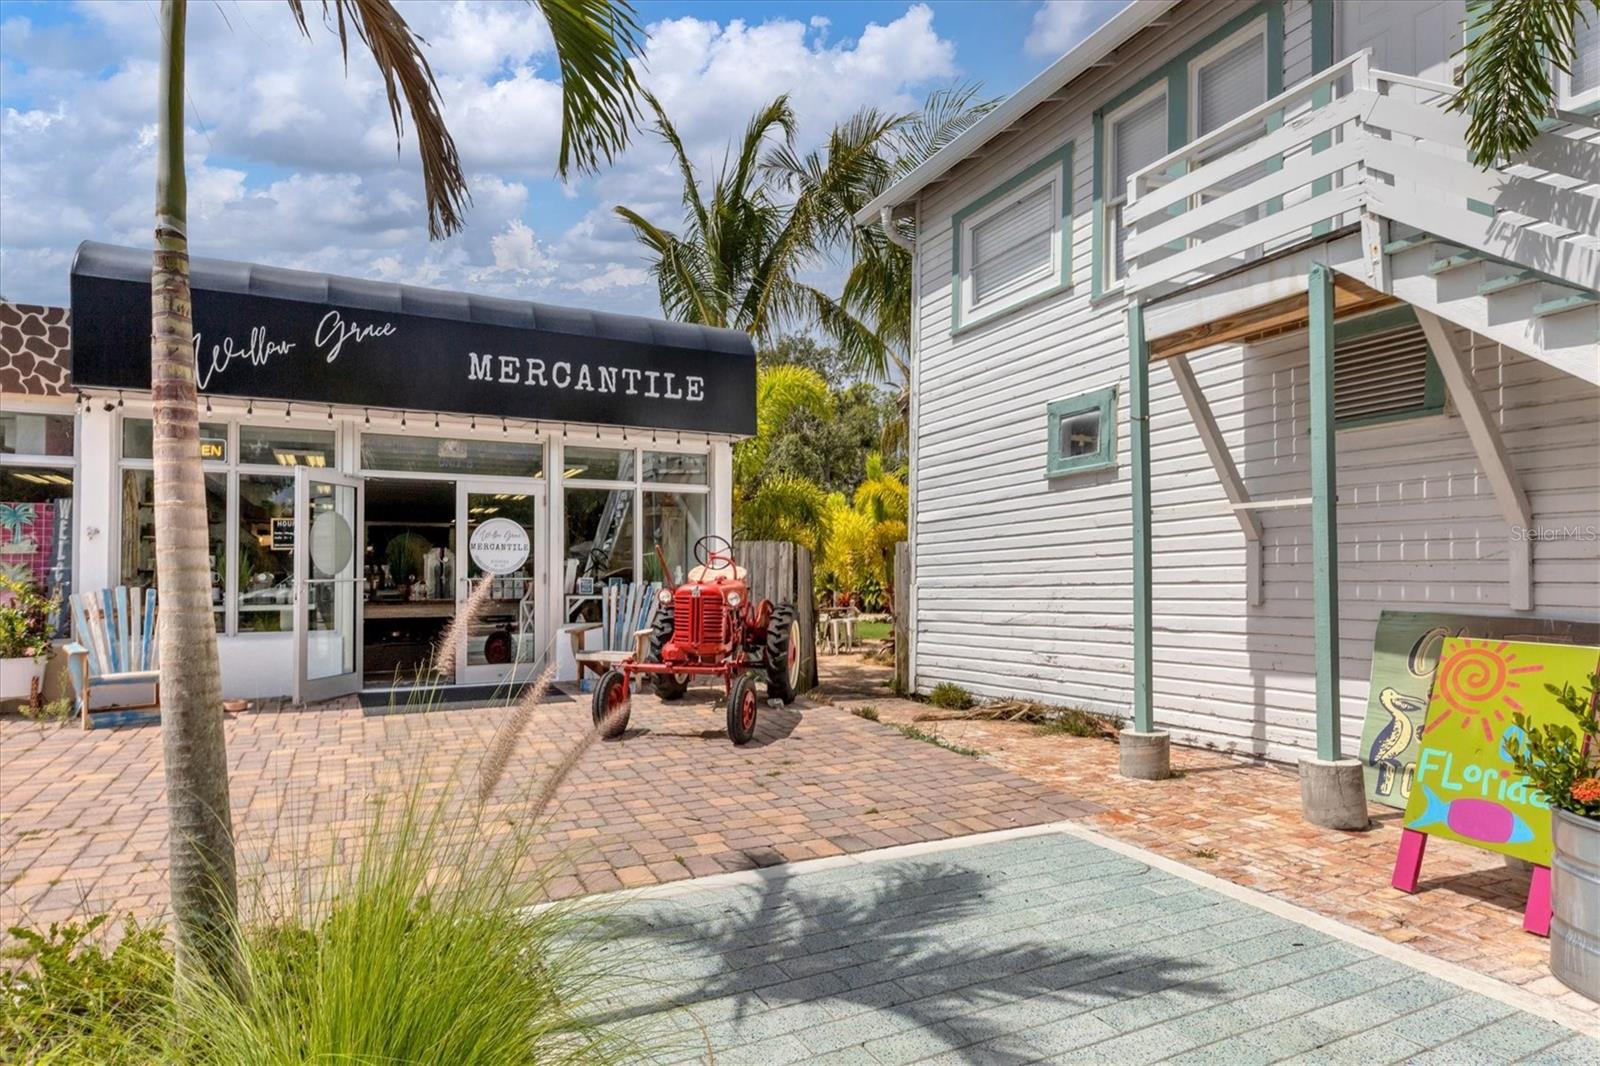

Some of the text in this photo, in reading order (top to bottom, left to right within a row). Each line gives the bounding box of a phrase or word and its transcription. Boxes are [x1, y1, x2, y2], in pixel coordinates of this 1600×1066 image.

[192, 310, 397, 390] Willow Grace
[468, 352, 705, 401] MERCANTILE
[201, 444, 222, 457] EN
[470, 543, 529, 551] MERCANTILE
